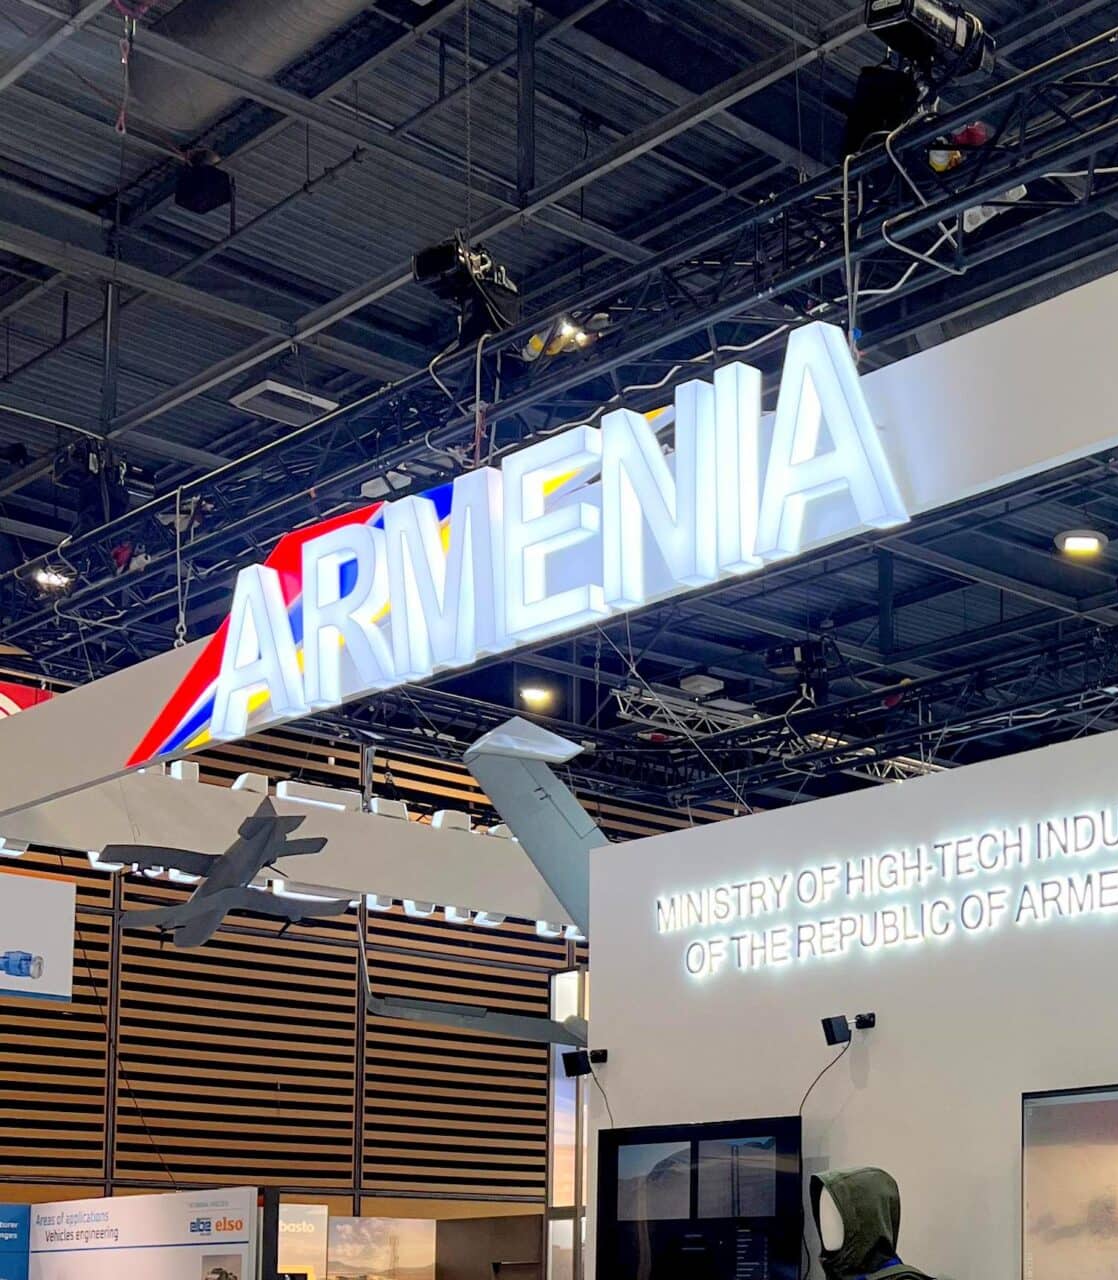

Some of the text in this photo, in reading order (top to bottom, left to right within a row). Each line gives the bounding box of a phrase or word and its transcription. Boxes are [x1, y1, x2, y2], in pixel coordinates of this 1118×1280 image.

[209, 320, 910, 741] ARMENIA
[656, 873, 788, 933] MINISTRY
[797, 866, 837, 905] OF
[845, 826, 1024, 896] HIGH-TECH
[685, 936, 726, 976] OF
[730, 927, 788, 969] THE
[797, 899, 952, 958] REPUBLIC
[959, 889, 1005, 931] OF
[36, 1210, 109, 1227] Areas of applications
[215, 1217, 243, 1232] elso
[280, 1219, 315, 1233] basto
[45, 1226, 119, 1243] Vehicles engineering
